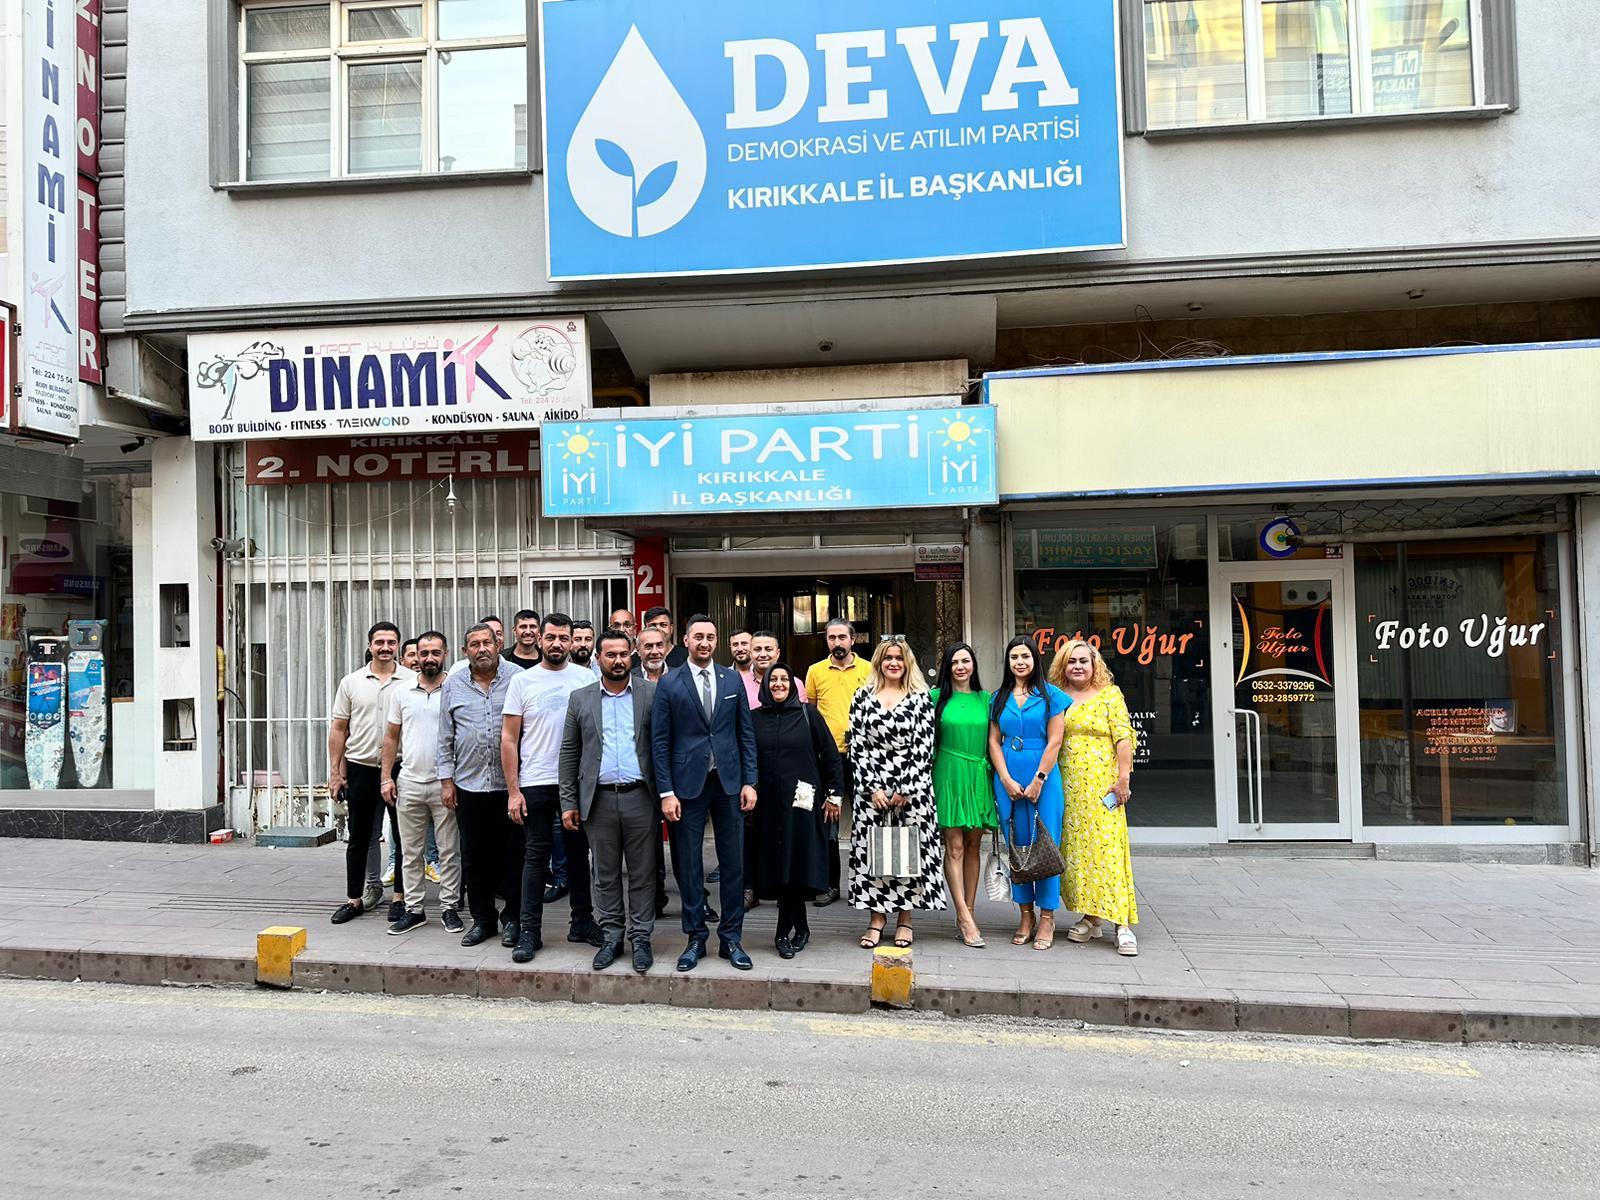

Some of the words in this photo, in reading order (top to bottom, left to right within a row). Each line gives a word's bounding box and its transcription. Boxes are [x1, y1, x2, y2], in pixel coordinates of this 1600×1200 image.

[723, 17, 1080, 130] DEVA
[727, 130, 868, 163] DEMOKRASİ
[873, 132, 905, 153] VE
[909, 125, 987, 150] ATILIM
[992, 114, 1080, 144] PARTİSİ
[727, 181, 874, 210] KIRIKKALE
[880, 171, 905, 200] İL
[910, 159, 1083, 201] BAŞKANLIĞI
[77, 47, 98, 370] NOTER
[44, 370, 55, 379] 224
[209, 424, 234, 434] BODY
[290, 419, 327, 431] FITNESS
[432, 410, 493, 425] KONDÜSYON
[502, 411, 535, 422] SAUNA
[544, 408, 579, 420] AİKİDO
[351, 434, 498, 447] KIRIKKALE
[615, 423, 694, 468] İYİ
[721, 414, 919, 465] PARTİ
[257, 456, 300, 478] 2.
[317, 440, 540, 477] NOTERLİ
[941, 454, 977, 484] İYİ
[562, 467, 596, 495] İYİ
[698, 469, 825, 485] KIRIKKALE
[672, 491, 693, 505] İL
[700, 485, 852, 507] BAŞKANLIĞI
[637, 564, 663, 594] 2.
[1112, 622, 1194, 665] Uğur
[1256, 640, 1310, 658] Uğur
[1261, 627, 1303, 641] Foto
[1375, 620, 1449, 650] Foto
[1459, 613, 1546, 658] Uğur
[1252, 680, 1315, 691] 0532-3379296
